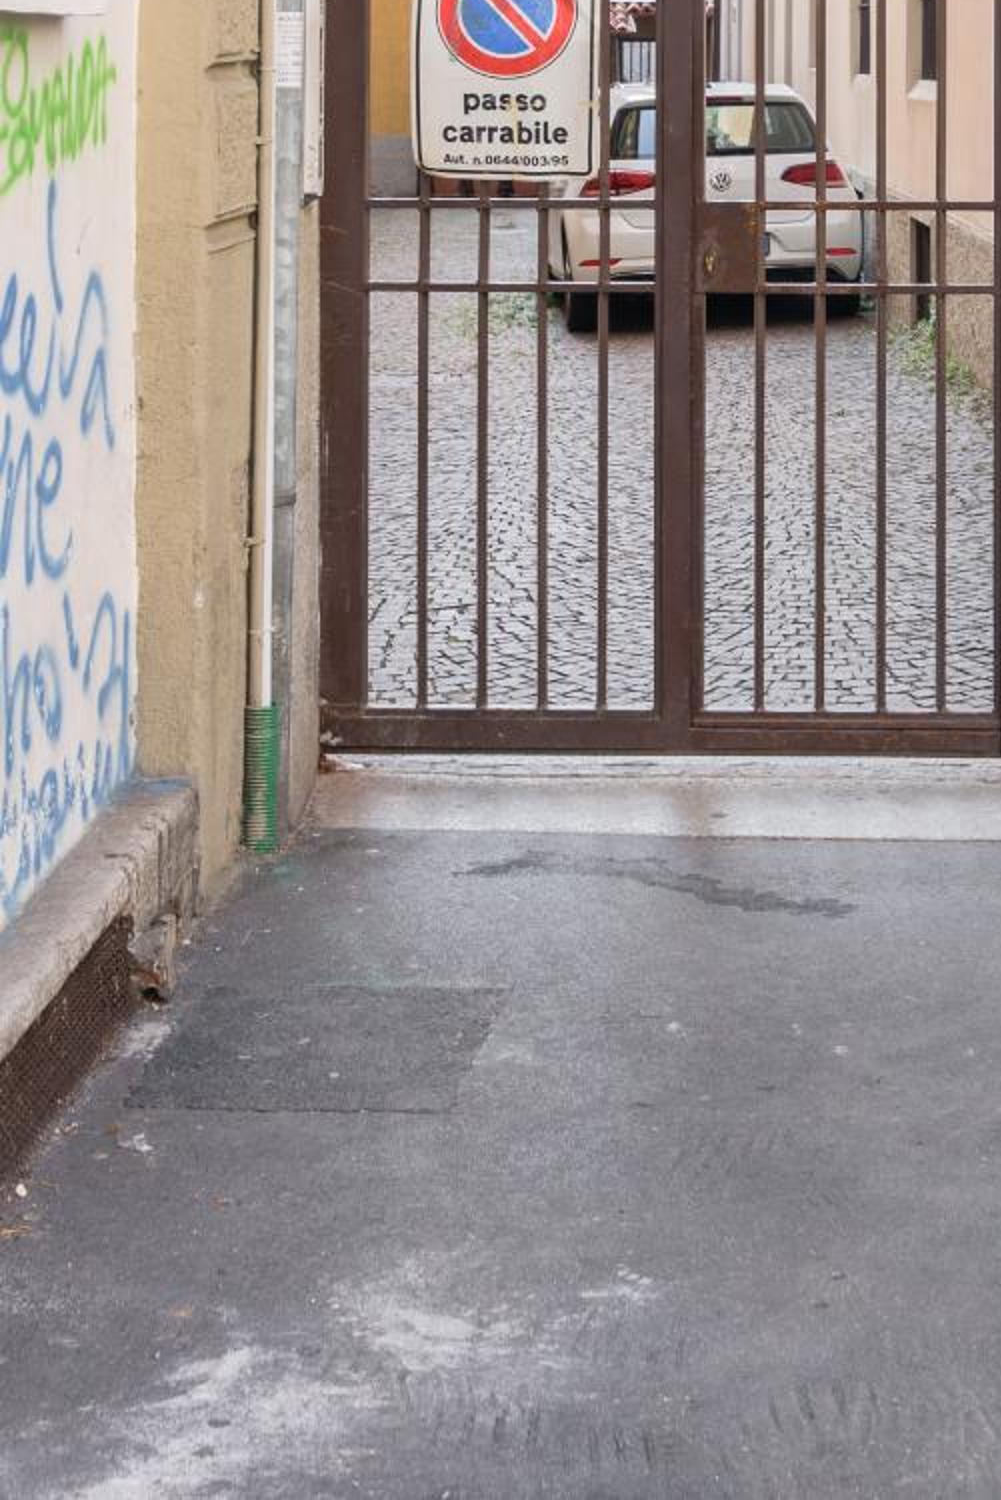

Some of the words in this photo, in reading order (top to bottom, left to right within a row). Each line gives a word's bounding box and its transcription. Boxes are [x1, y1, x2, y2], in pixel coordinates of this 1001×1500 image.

[463, 93, 547, 115] passo
[442, 121, 569, 144] carrabile
[443, 153, 468, 164] Aut.
